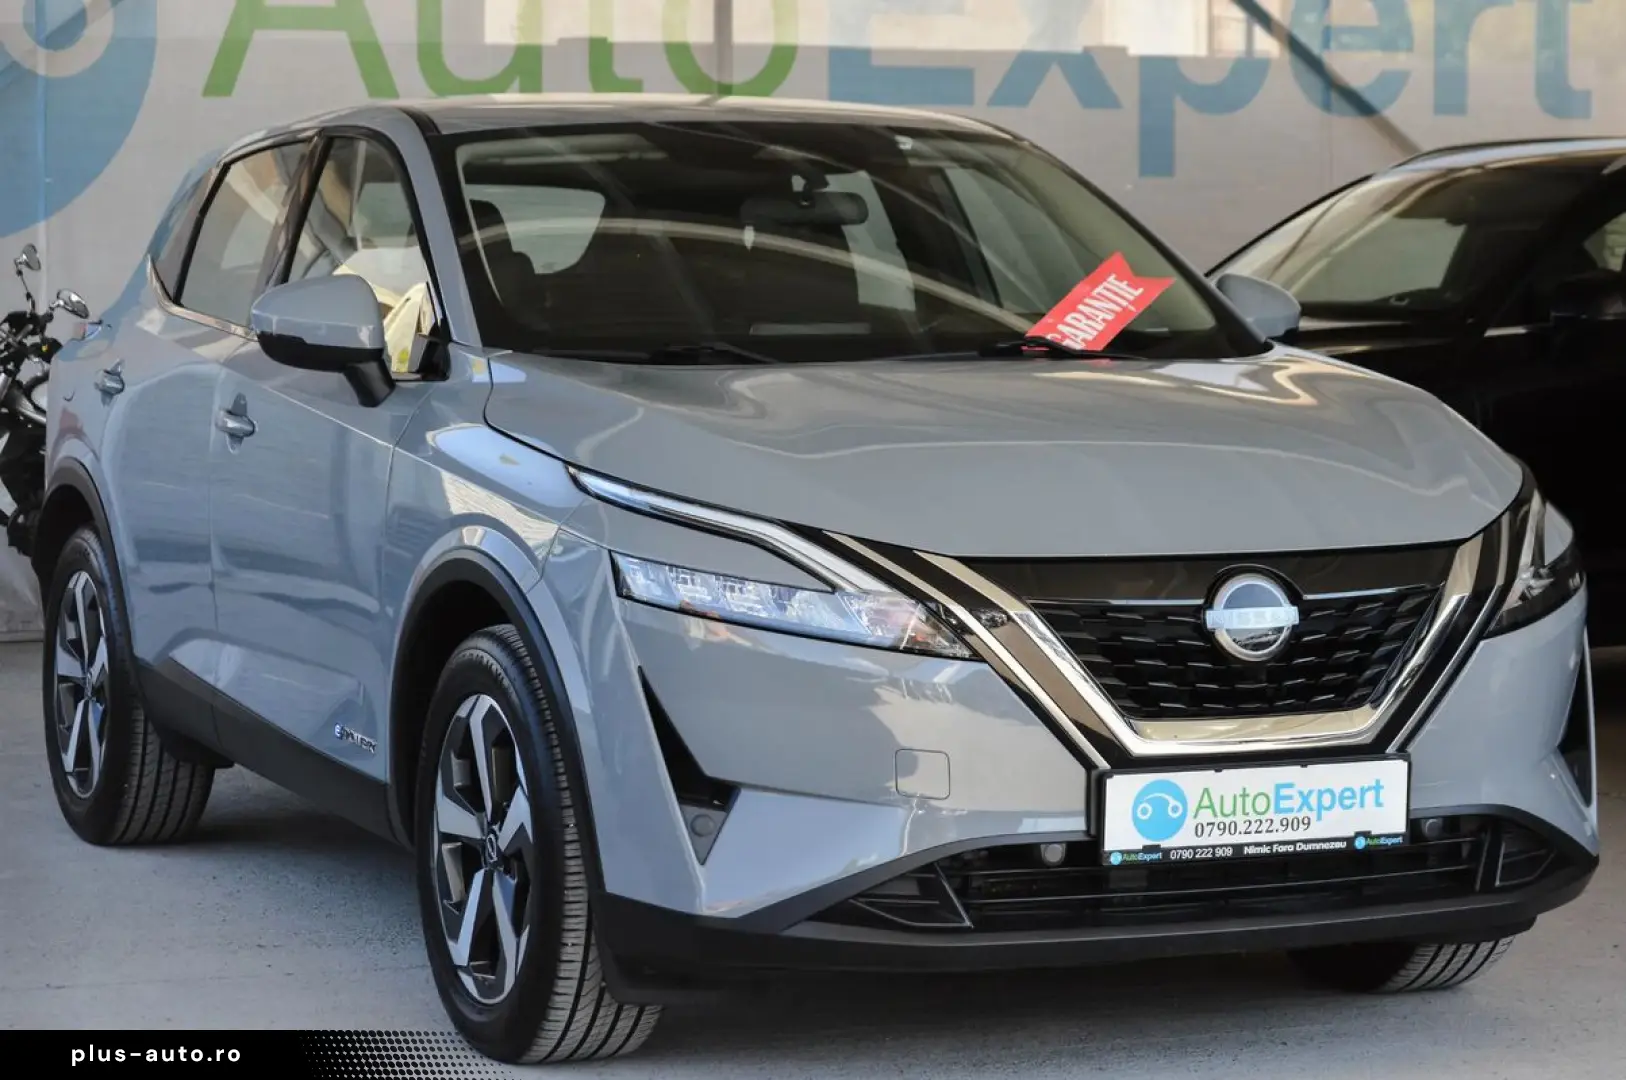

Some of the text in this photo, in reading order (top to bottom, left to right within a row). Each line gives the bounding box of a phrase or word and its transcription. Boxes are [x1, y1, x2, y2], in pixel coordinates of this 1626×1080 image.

[1193, 779, 1384, 822] AutoExpert
[1195, 816, 1311, 838] 0790.222.909
[1170, 847, 1233, 860] 0790 222 909
[1244, 844, 1271, 855] Nimic
